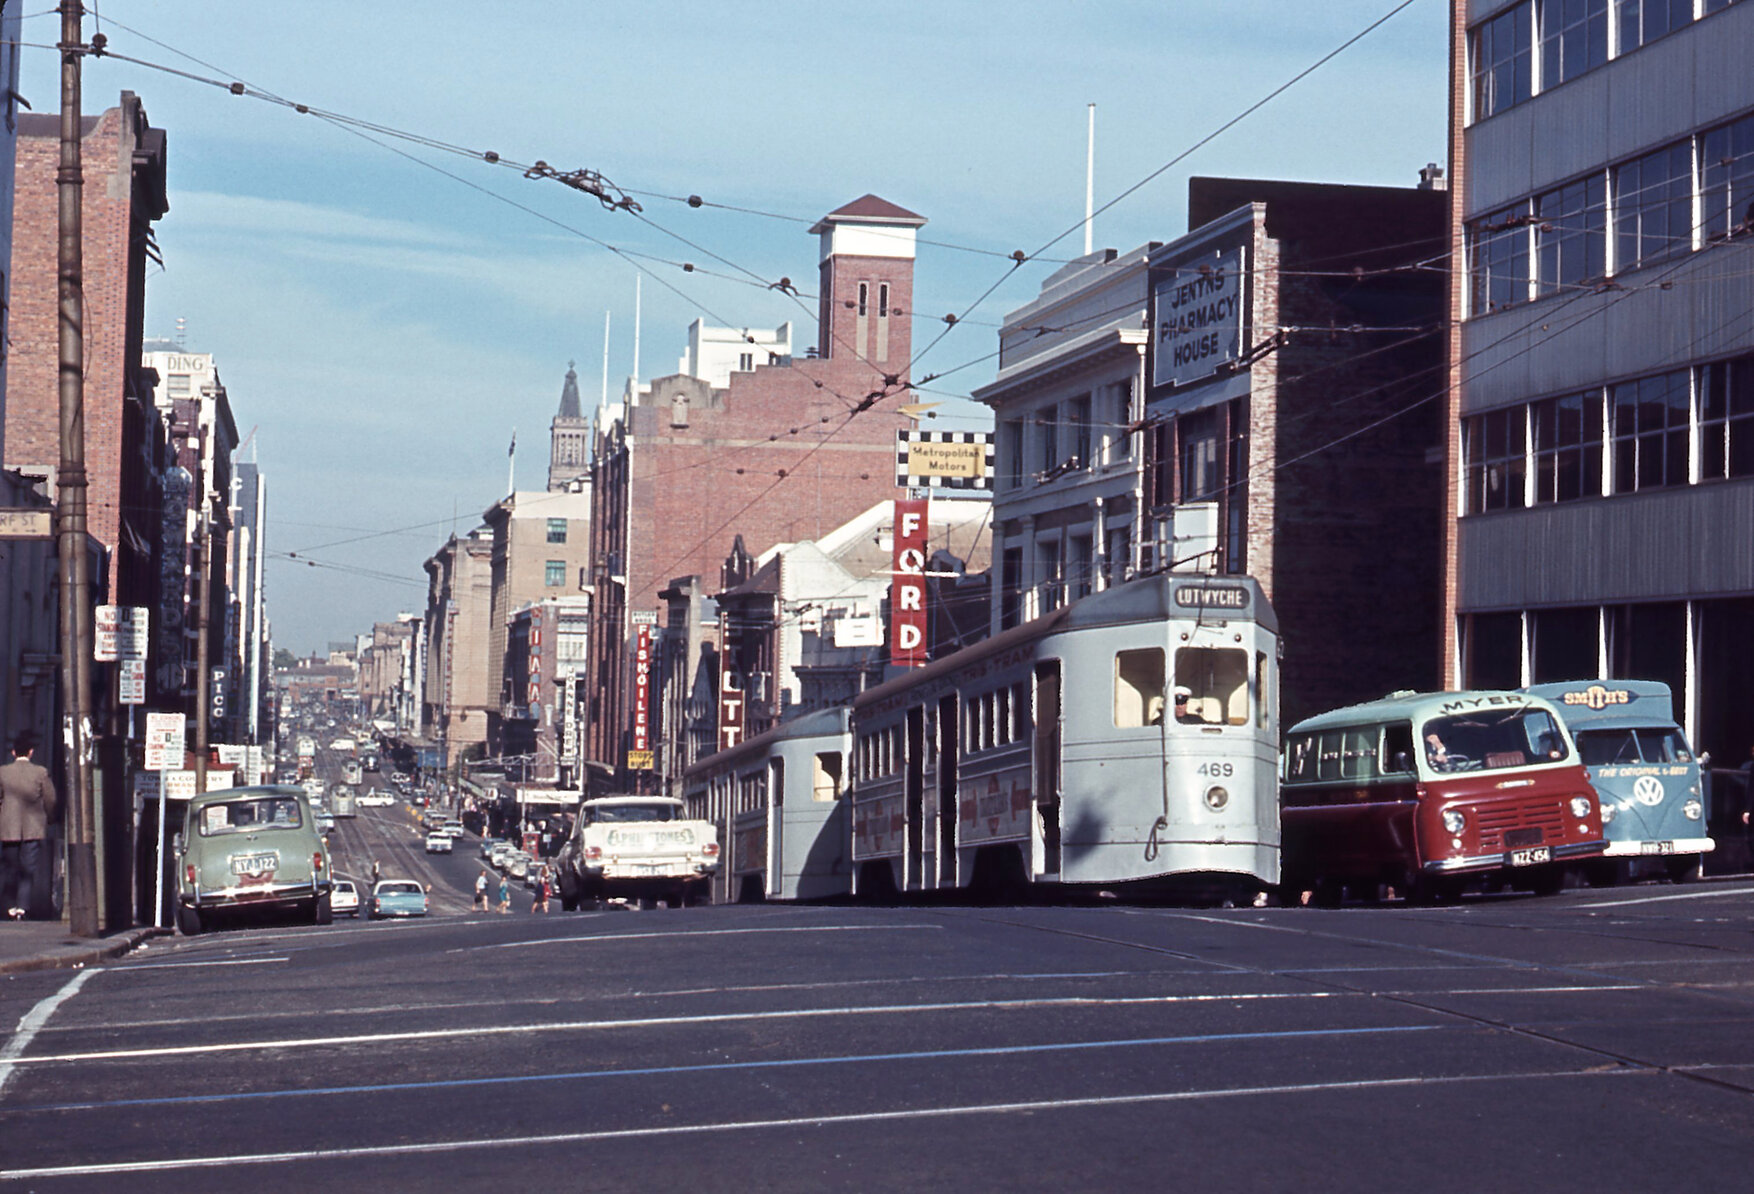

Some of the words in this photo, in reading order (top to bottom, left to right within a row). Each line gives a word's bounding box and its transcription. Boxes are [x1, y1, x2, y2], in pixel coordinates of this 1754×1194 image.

[1160, 293, 1238, 343] PHARMACY
[1173, 332, 1218, 367] HOUSE
[913, 446, 980, 459] Metropolitan
[929, 461, 967, 471] Motors
[22, 515, 36, 526] ST
[899, 513, 924, 650] FORD
[1177, 588, 1243, 605] LUTWYCHE
[1443, 695, 1523, 712] MYER
[1197, 762, 1234, 778] 469
[1599, 768, 1617, 777] THE
[1619, 767, 1661, 777] ORIGINAL
